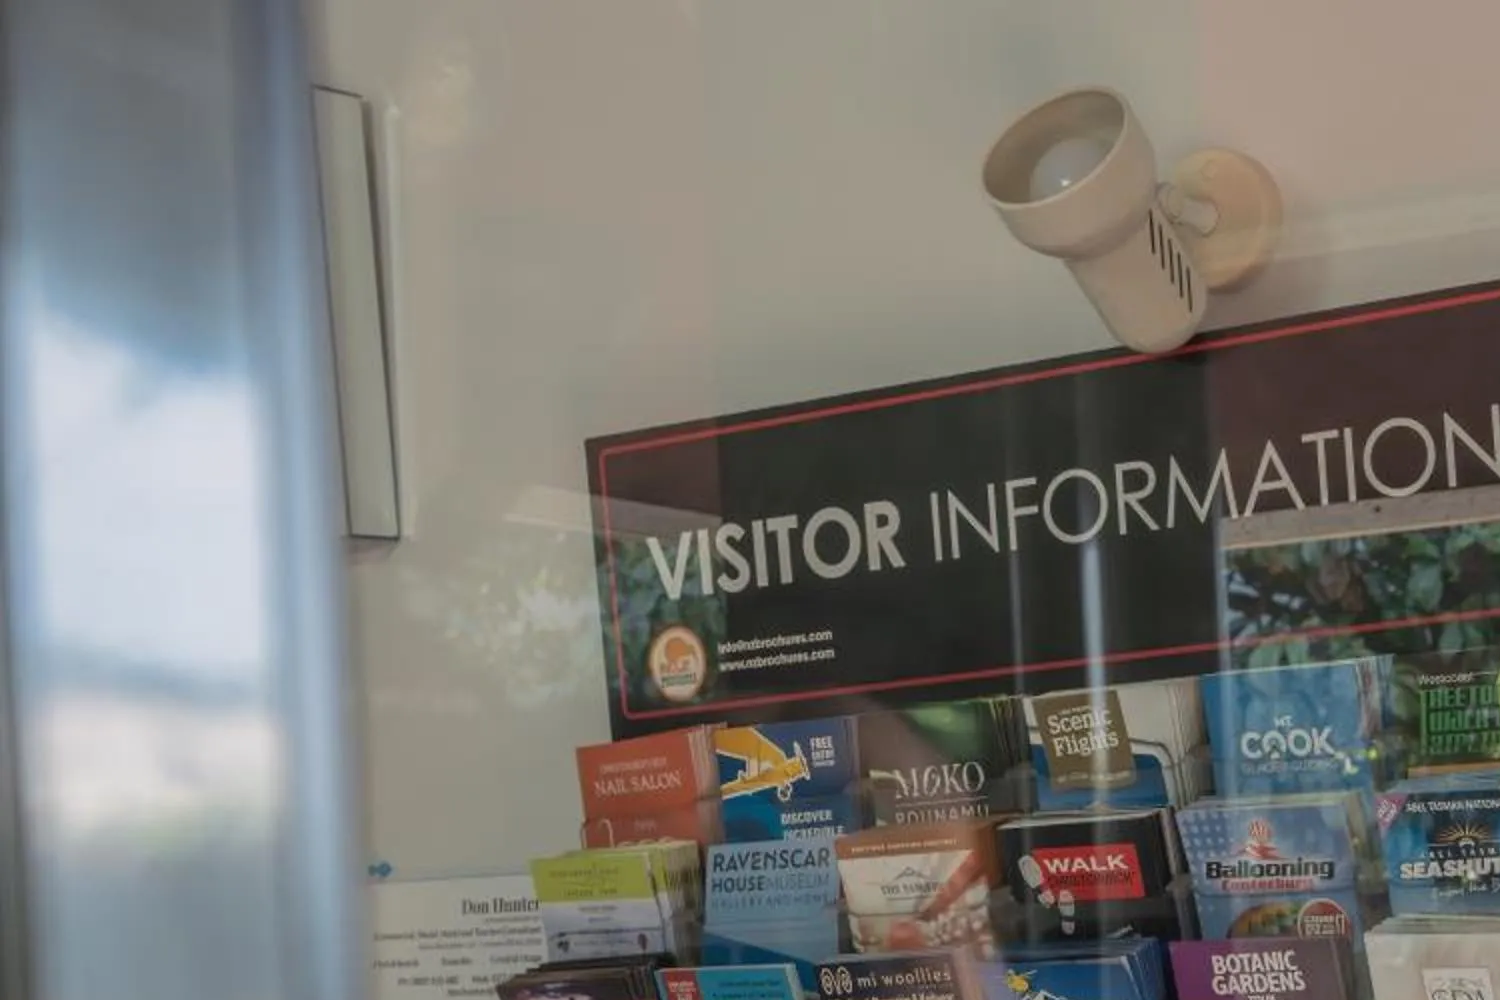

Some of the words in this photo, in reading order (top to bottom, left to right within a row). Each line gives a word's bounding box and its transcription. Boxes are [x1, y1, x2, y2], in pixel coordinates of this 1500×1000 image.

[647, 501, 905, 600] VISITOR
[1047, 710, 1113, 735] Scenic
[809, 736, 833, 750] FREE
[1053, 731, 1120, 758] Flights
[1241, 726, 1336, 760] COOK
[594, 779, 628, 798] NAIL
[629, 768, 683, 793] SALON
[893, 761, 987, 800] MOKO
[780, 809, 833, 826] DISCOVER
[712, 846, 831, 874] RAVENSCAR
[1046, 855, 1129, 873] WALK
[1206, 857, 1335, 882] Ballooning
[711, 875, 766, 894] HOUSE
[1211, 950, 1299, 976] BOTANIC
[1212, 971, 1306, 996] GARDENS
